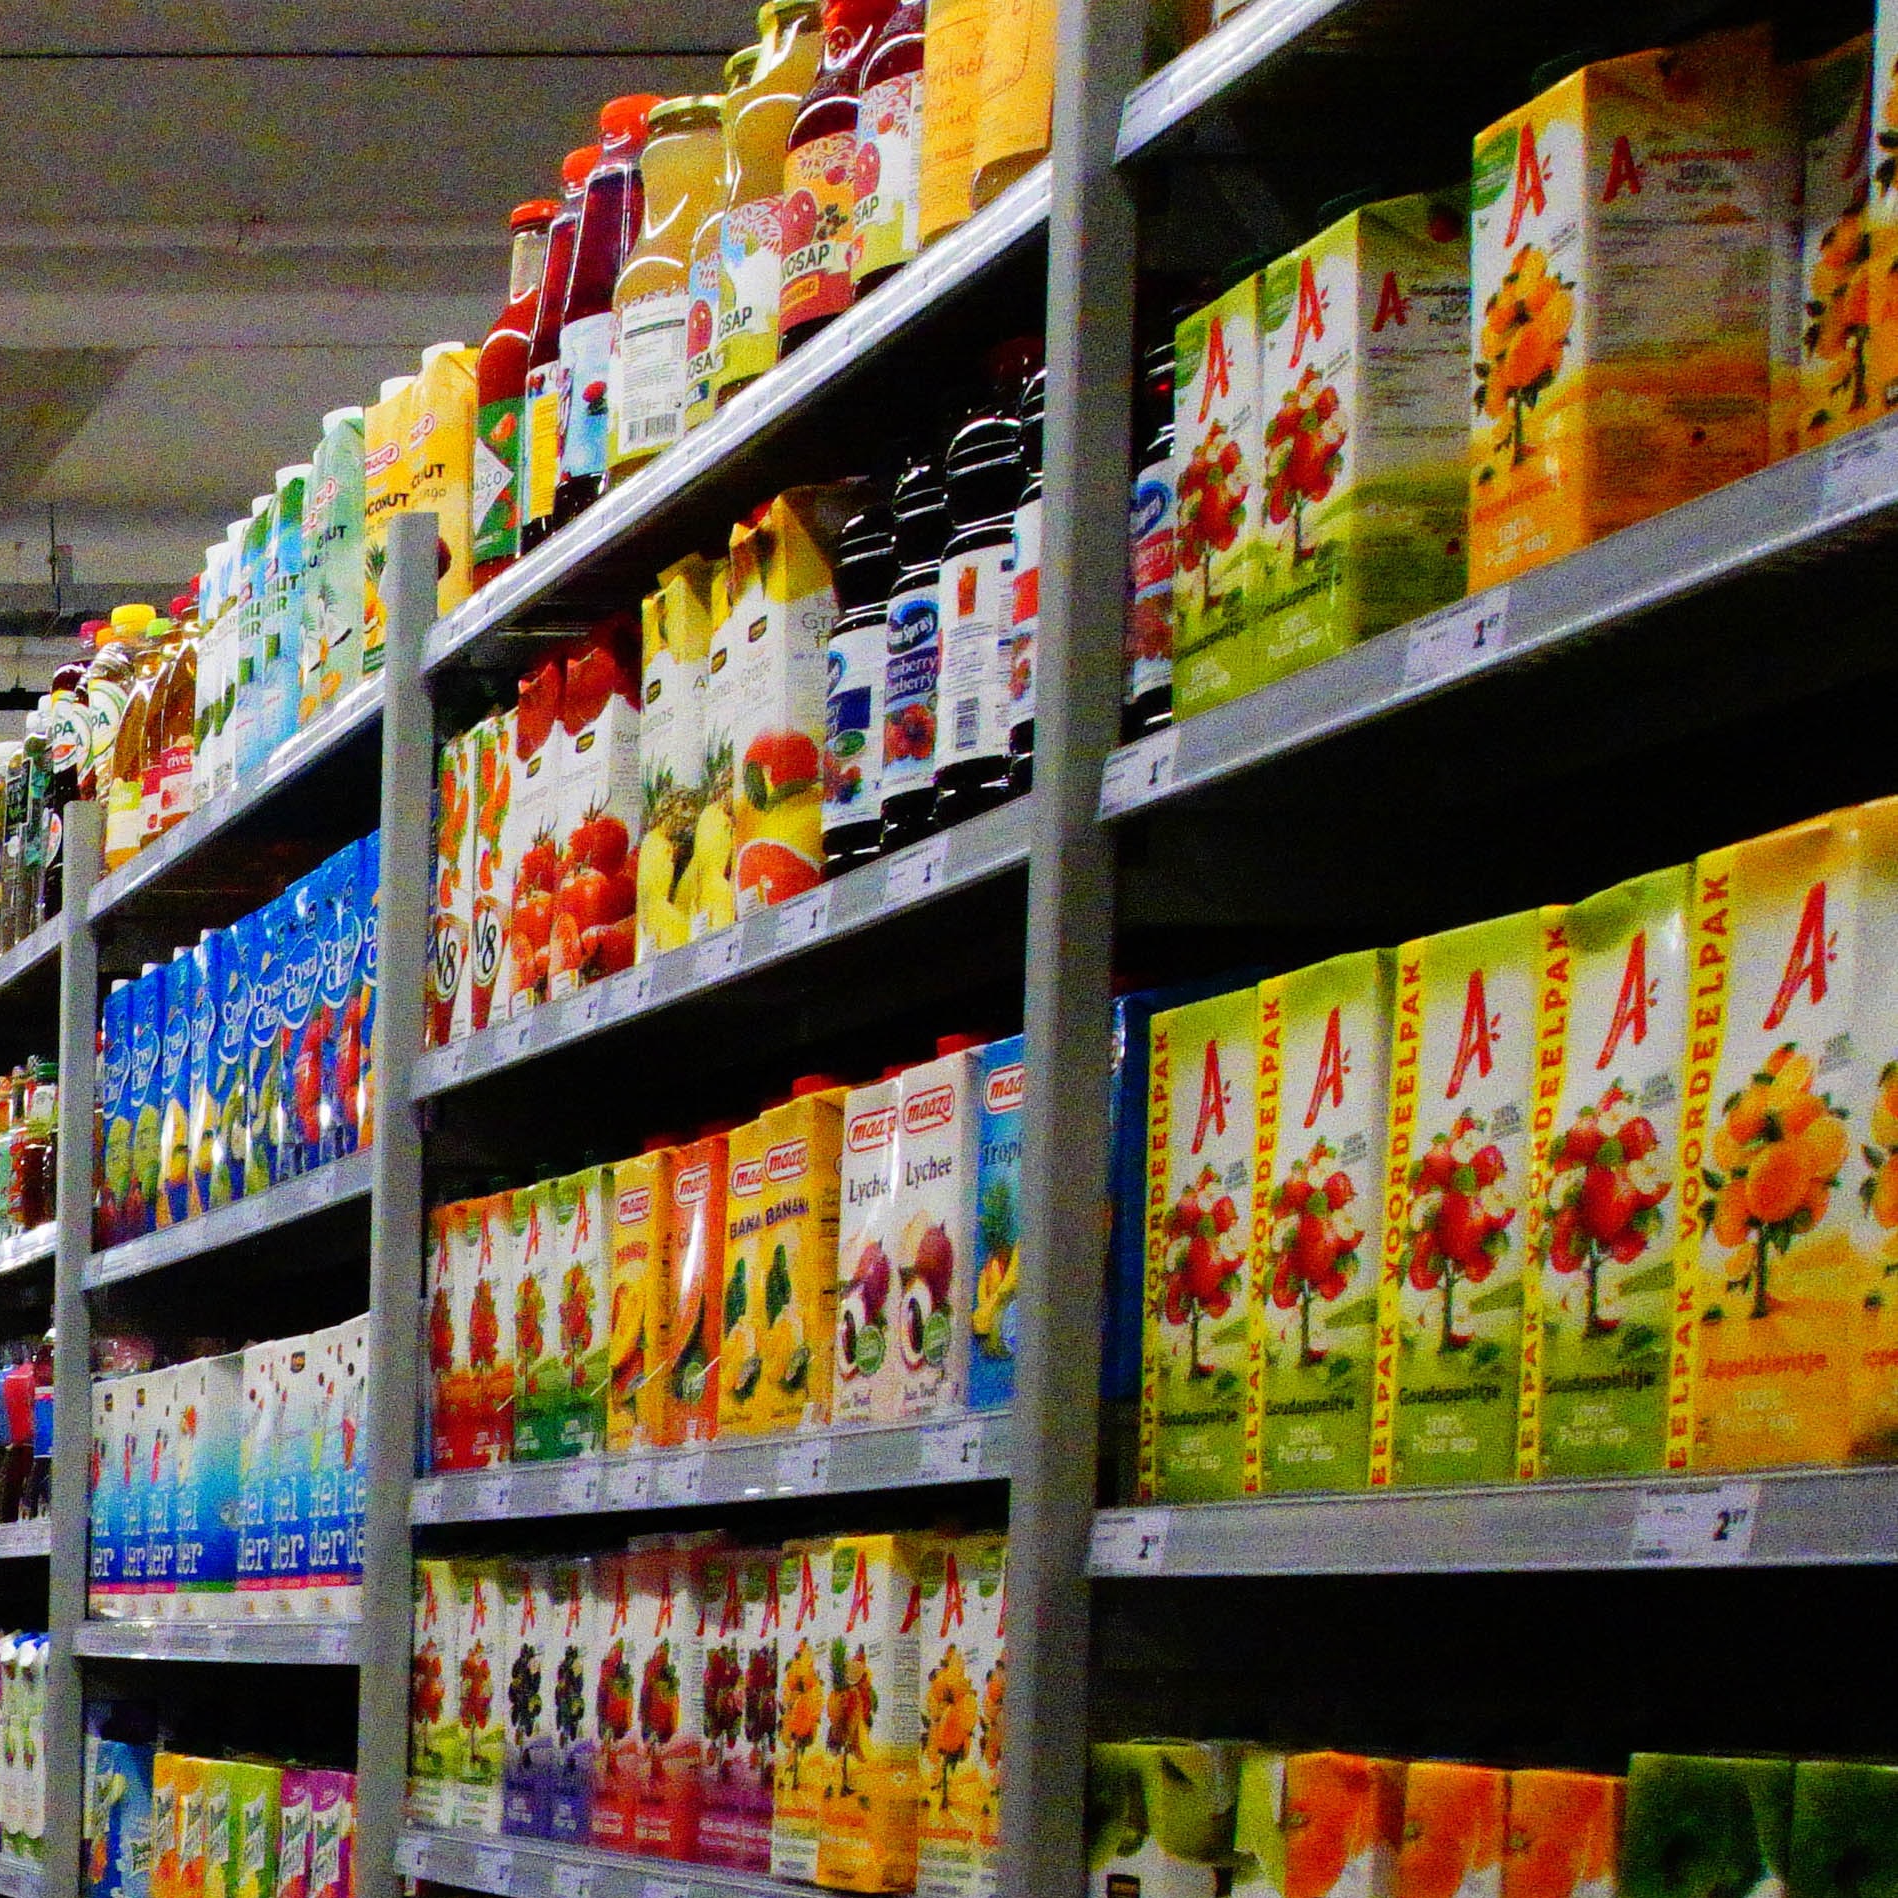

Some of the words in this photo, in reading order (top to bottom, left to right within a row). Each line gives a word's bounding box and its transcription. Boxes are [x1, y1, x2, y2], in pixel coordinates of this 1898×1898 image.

[1596, 932, 1649, 1069] A
[1763, 882, 1833, 1030] A
[988, 1068, 1025, 1109] maa
[1192, 1040, 1229, 1154] A
[1304, 1009, 1347, 1128] A
[1446, 971, 1497, 1099] A
[1528, 926, 1568, 1278] VOORDEELPAK
[1681, 874, 1732, 1242] VOORDEELPAK
[905, 1093, 954, 1125] maaza
[905, 1155, 953, 1187] Lychee
[1253, 999, 1283, 1304] VOORDEELPAK
[1385, 962, 1424, 1294] VOORDEELPAK
[730, 1217, 762, 1241] BANA
[1369, 1325, 1394, 1486] EELPAK
[1518, 1310, 1537, 1480] EELPAK
[1669, 1288, 1695, 1470] EELPAK
